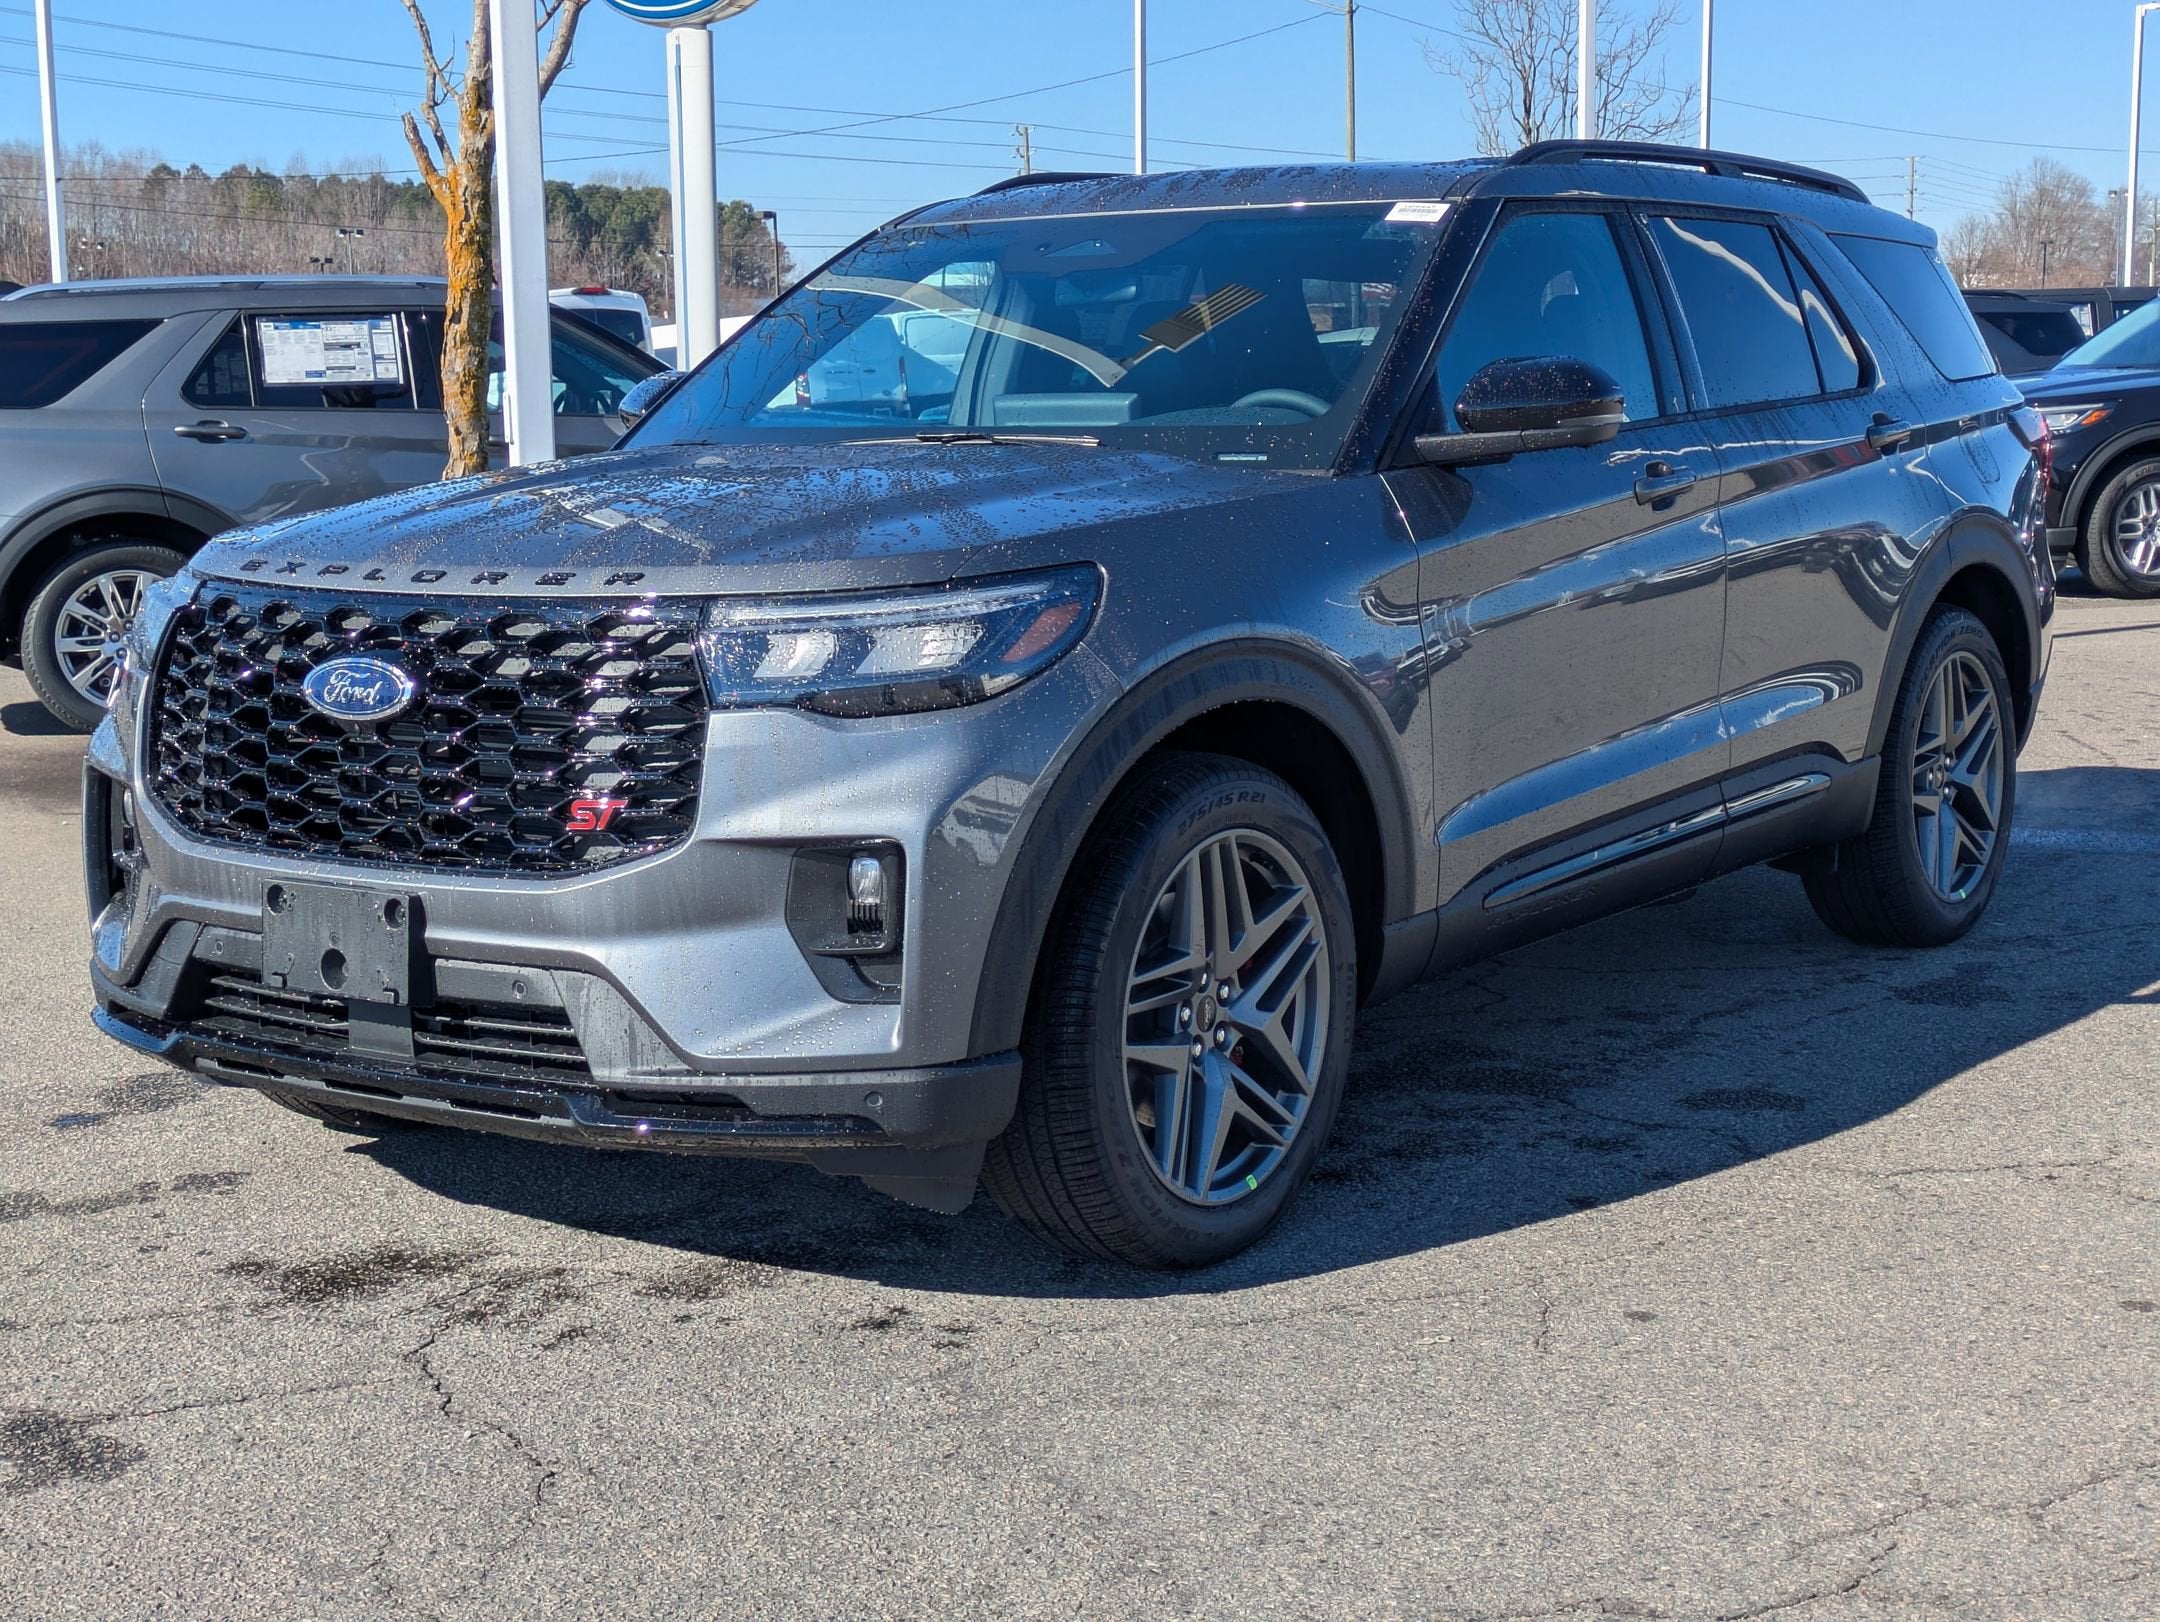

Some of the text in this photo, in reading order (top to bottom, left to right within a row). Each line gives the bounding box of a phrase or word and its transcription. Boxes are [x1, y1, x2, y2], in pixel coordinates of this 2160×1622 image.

[2135, 462, 2160, 478] KINER
[240, 558, 646, 586] EXPLORER
[1959, 625, 1984, 639] ZERO
[323, 669, 383, 705] Ford
[566, 799, 629, 831] ST
